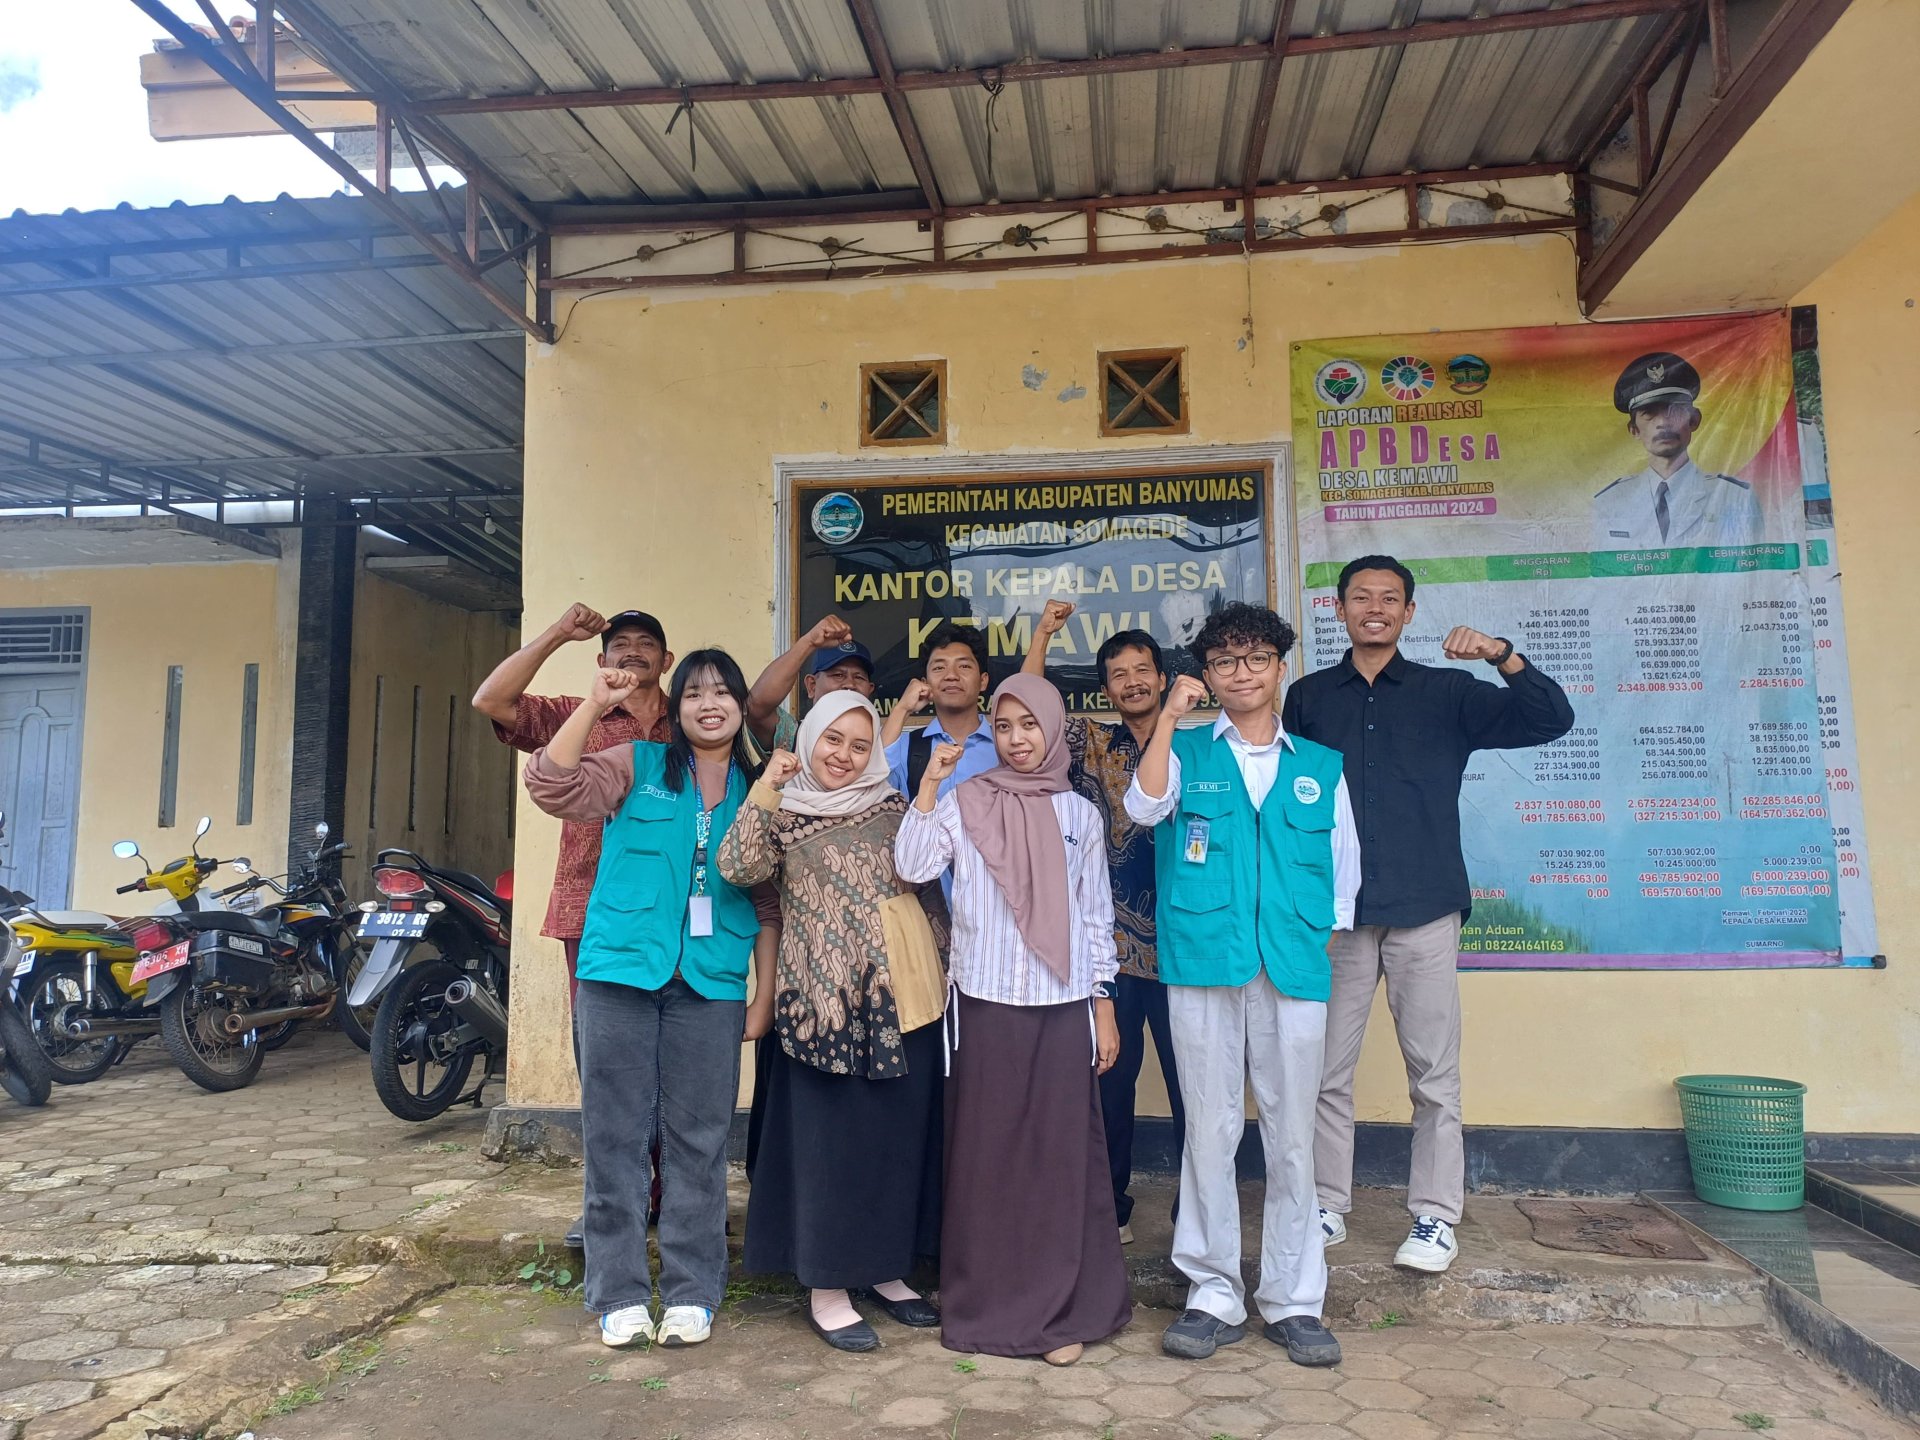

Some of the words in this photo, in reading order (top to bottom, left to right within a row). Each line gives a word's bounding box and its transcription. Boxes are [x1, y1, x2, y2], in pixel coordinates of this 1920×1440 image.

[1317, 406, 1393, 428] LAPORAN
[1395, 400, 1482, 422] REALISASI
[1319, 470, 1370, 490] DESA
[1374, 465, 1458, 487] KEMAWI
[883, 489, 1008, 515] PEMERINTAH
[1014, 483, 1133, 510] KABUPATEN
[1139, 477, 1255, 504] BANYUMAS
[1321, 490, 1345, 502] KEC.
[1345, 487, 1404, 500] SOMAGEDE
[1405, 486, 1431, 497] KAB.
[1432, 482, 1494, 496] BANYUMAS
[1334, 506, 1375, 520] TAHUN
[1378, 502, 1447, 518] ANGGARAN
[1451, 501, 1484, 514] 2024
[945, 520, 1066, 547] KECAMATAN
[1072, 515, 1189, 542] SOMAGEDE
[1513, 557, 1570, 566] ANGGARAN
[1616, 552, 1670, 562] REALISASI
[1708, 546, 1785, 558] LEBIH/KURANG
[1533, 569, 1552, 577] (Rp)
[1633, 563, 1654, 573] (Rp)
[1738, 559, 1759, 569] (Rp)
[835, 569, 973, 602] KANTOR
[986, 565, 1120, 596] KEPALA
[1131, 560, 1226, 593] DESA
[1530, 609, 1589, 617] 36.161.420,00
[1637, 604, 1695, 614] 26.625.738,00
[1743, 601, 1797, 610] 9.535.682,00
[1315, 626, 1337, 635] Dana
[1518, 620, 1589, 629] 1.440.403.000,00
[1625, 616, 1696, 625] 1.440.403.000,00
[1779, 612, 1798, 621] 0,00
[1315, 636, 1335, 646] Bagi
[1404, 634, 1444, 643] Retribusi
[1526, 631, 1590, 640] 109.682.499,00
[1634, 627, 1697, 636] 121.726.234,00
[1740, 623, 1799, 632] 12.043.735,00
[1527, 642, 1591, 651] 578.993.337,00
[1634, 638, 1698, 647] 578.993.337,00
[1781, 634, 1800, 643] 0,00
[1527, 653, 1592, 662] 100.000.000,00
[1636, 649, 1699, 658] 100.000.000,00
[1782, 645, 1801, 654] 0,00
[1641, 660, 1700, 669] 66.639.000,00
[1783, 656, 1801, 665] 0,00
[1642, 671, 1701, 680] 13.621.624,00
[1758, 667, 1803, 676] 223.537,00
[1618, 682, 1703, 692] 2.348.008.933,00
[1740, 678, 1804, 689] 2.284.516,00
[1640, 725, 1704, 734] 664.852.784,00
[1749, 723, 1808, 731] 97.689.586,00
[1633, 737, 1705, 746] 1.470.905.450,00
[1750, 734, 1809, 743] 38.193.550,00
[1538, 750, 1599, 759] 76.979.500,00
[1645, 748, 1706, 757] 68.344.500,00
[1755, 745, 1810, 754] 8.635.000,00
[1534, 762, 1600, 770] 227.334.900,00
[1641, 759, 1707, 768] 215.043.500,00
[1752, 756, 1811, 765] 12.291.400,00
[1535, 773, 1600, 781] 261.554.310,00
[1642, 770, 1708, 779] 256.078.000,00
[1757, 768, 1812, 776] 5.476.310,00
[1514, 800, 1601, 810] 2.837.510.080,00
[1627, 798, 1716, 809] 2.675.224.234,00
[1743, 795, 1820, 805] 162.285.846,00
[1521, 813, 1605, 824] (491.785.663,00)
[1634, 811, 1721, 822] (327.215.301,00)
[1739, 808, 1827, 820] (164.570.362,00)
[1540, 850, 1605, 858] 507.030.902,00
[1647, 848, 1716, 856] 507.030.902,00
[1801, 845, 1821, 854] 0,00
[1545, 861, 1606, 869] 15.245.239,00
[1654, 859, 1716, 868] 10.245.000,00
[1763, 857, 1822, 865] 5.000.239,00
[1529, 875, 1607, 884] 491.785.663,00
[1638, 872, 1720, 883] 496.785.902,00
[1752, 870, 1829, 881] (5.000.239,00)
[1587, 889, 1609, 898] 0,00
[1640, 887, 1721, 898] 169.570.601,00
[1741, 885, 1831, 897] (169.570.601,00)
[360, 912, 371, 925] R
[377, 912, 406, 925] 3812
[412, 913, 430, 925] RG
[1485, 924, 1524, 935] Aduan
[175, 944, 188, 955] XH
[1485, 940, 1564, 951] 082241641163
